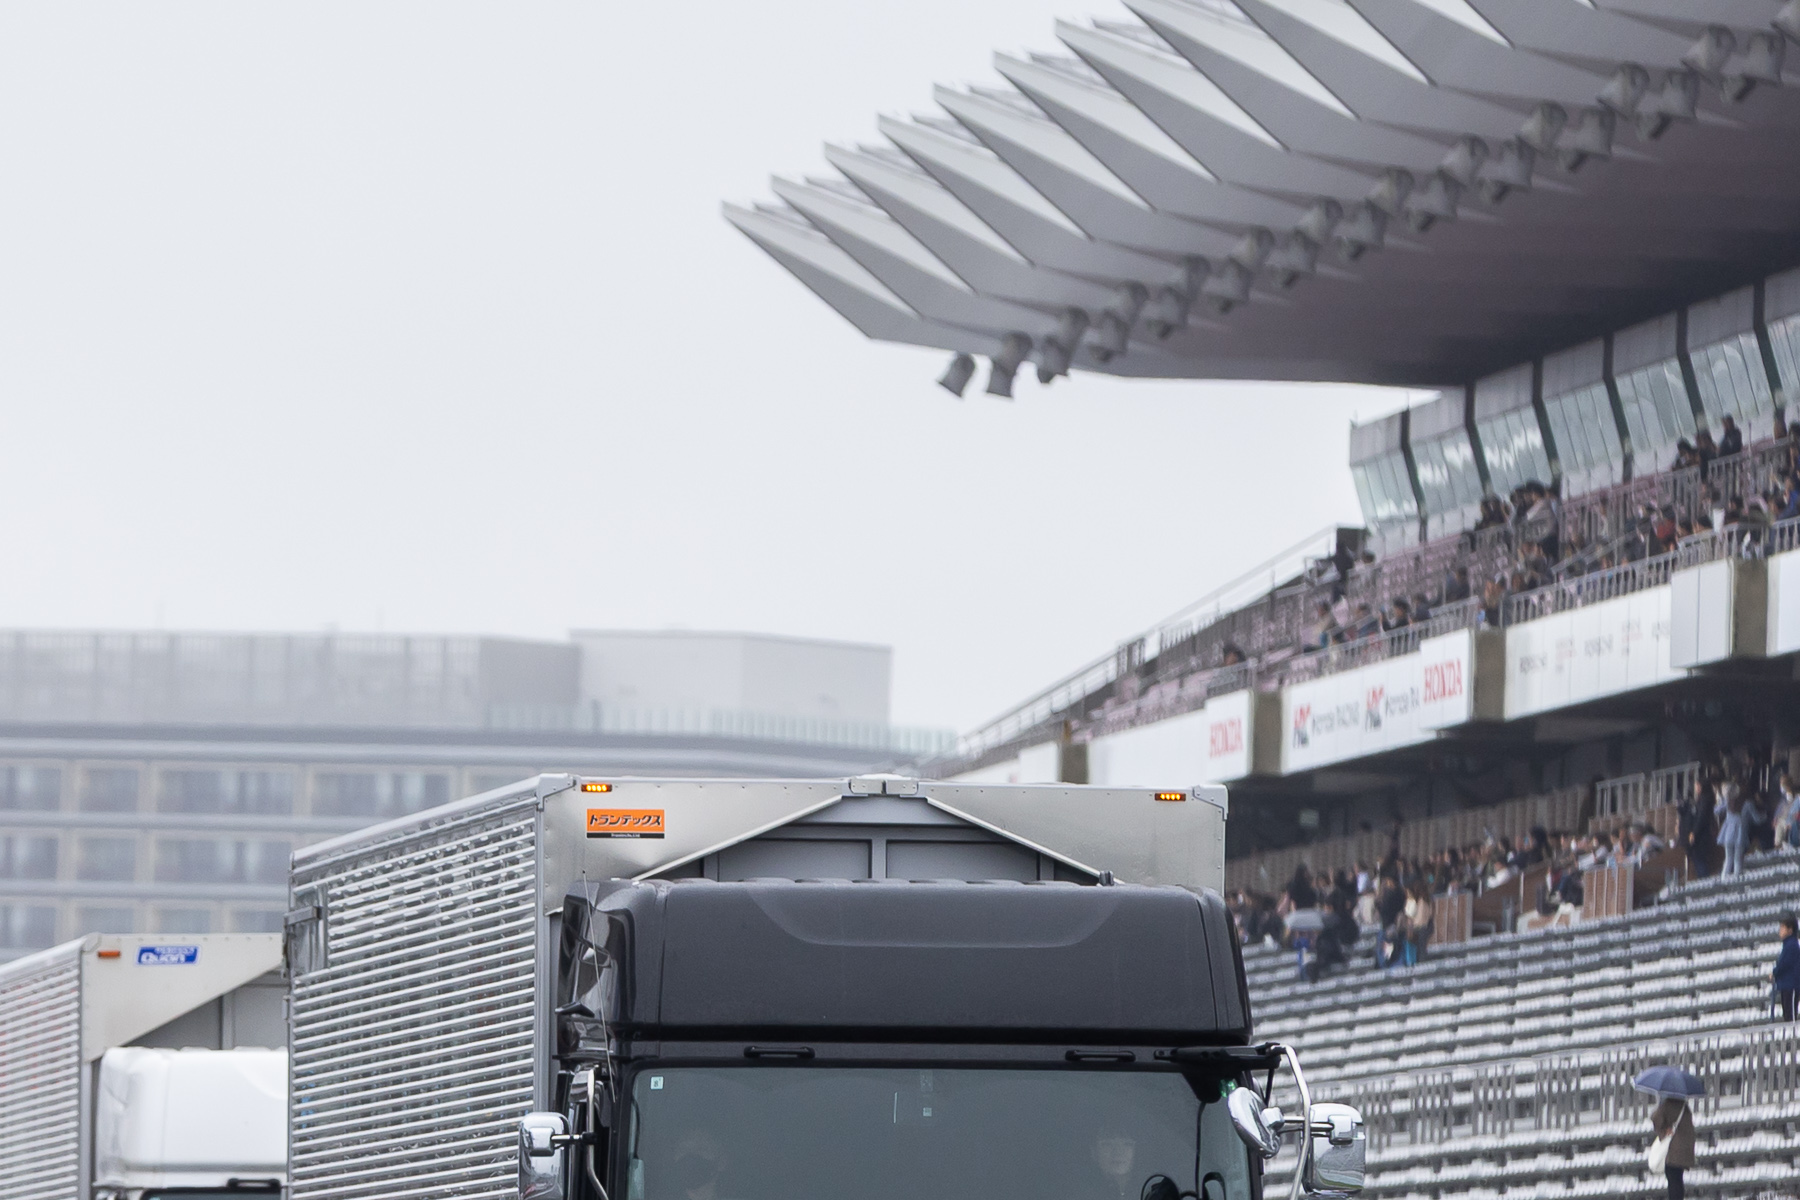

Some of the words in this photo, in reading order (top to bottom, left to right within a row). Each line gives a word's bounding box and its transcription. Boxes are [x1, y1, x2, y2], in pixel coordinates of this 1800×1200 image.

[1422, 657, 1464, 704] HONDA
[589, 814, 662, 827] トランテックス
